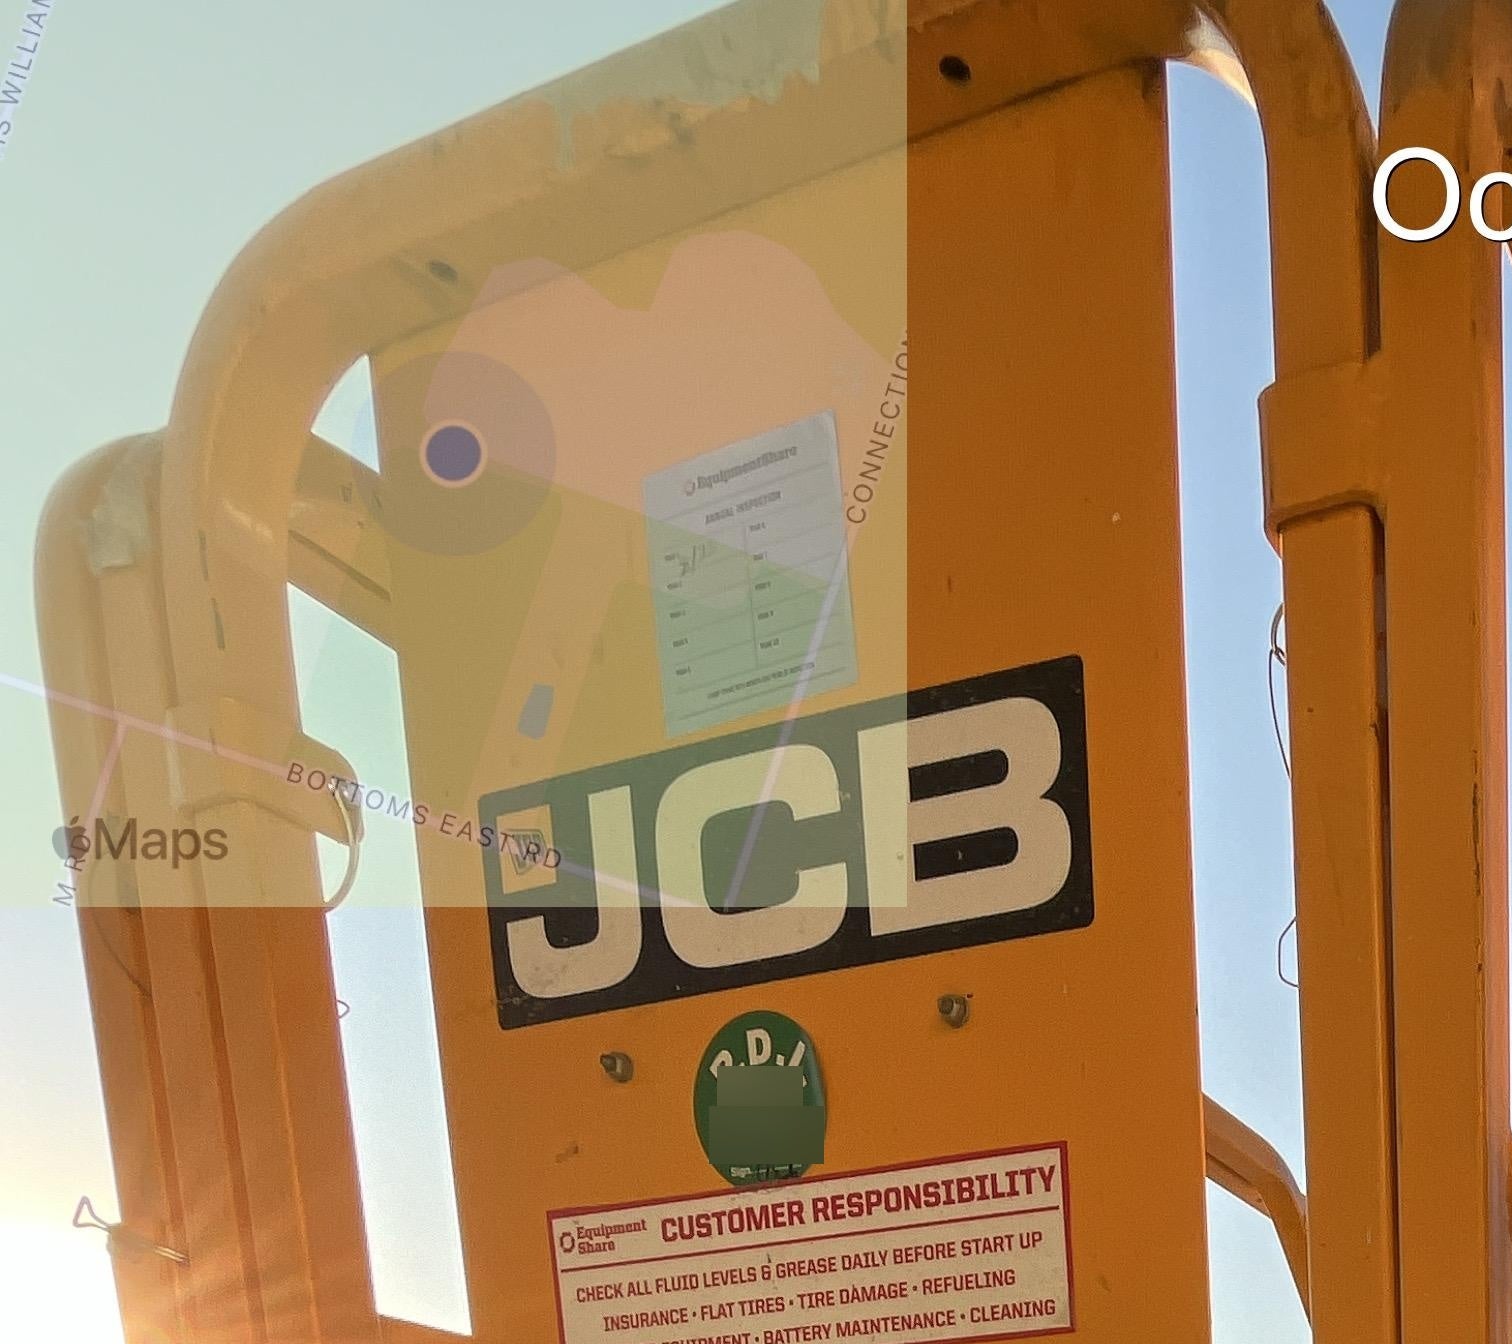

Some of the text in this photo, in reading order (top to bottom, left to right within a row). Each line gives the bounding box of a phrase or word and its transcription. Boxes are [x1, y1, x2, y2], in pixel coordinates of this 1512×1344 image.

[505, 696, 1074, 1000] JCB
[576, 1219, 648, 1241] Equipment
[661, 1165, 1056, 1243] CUSTOMER RESPONSIBILITY
[576, 1231, 1044, 1303] CHECK ALL FLUID LEVELS & GREASE DAILY BEFORE START UP
[577, 1239, 616, 1255] Share
[603, 1269, 1016, 1332] INSURANCE FLAT TIRES TIRE DAMAGE REFUELING
[836, 1310, 956, 1338] MAINTENANCE
[970, 1299, 1056, 1324] CLEANING
